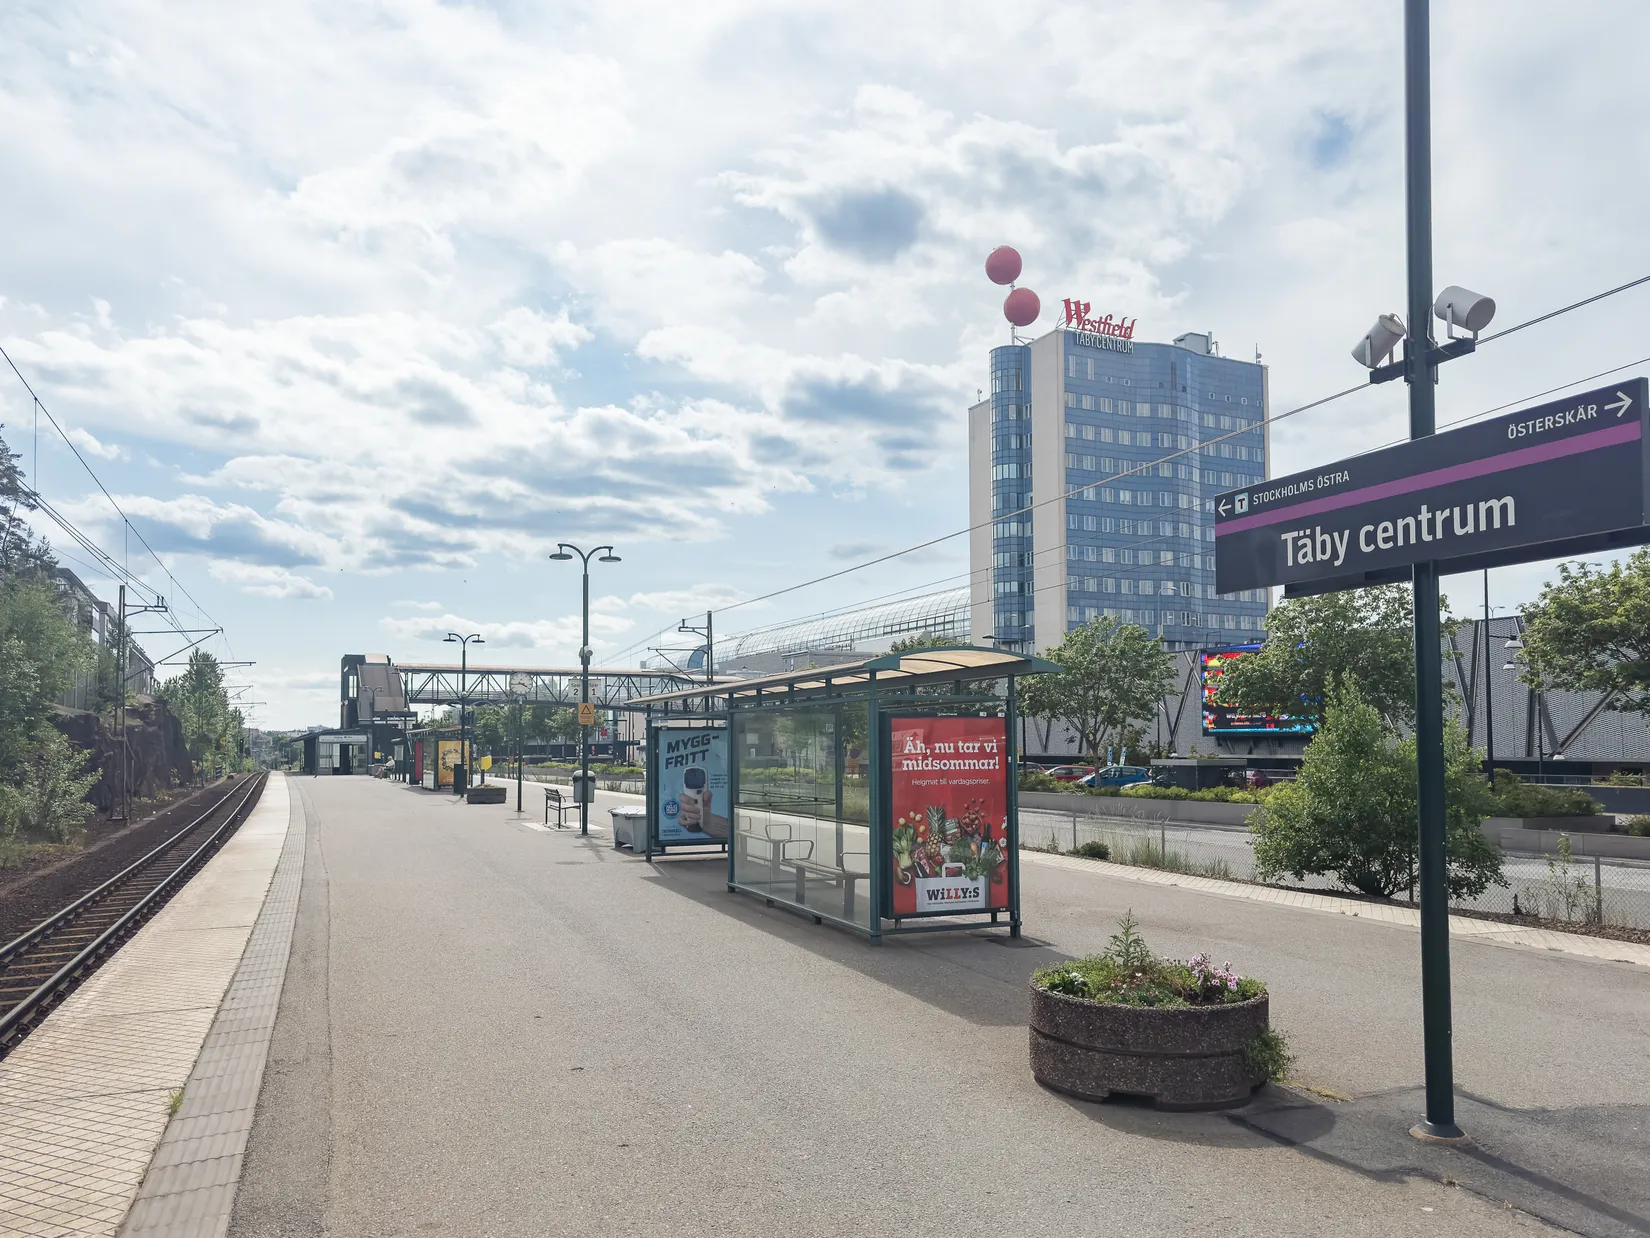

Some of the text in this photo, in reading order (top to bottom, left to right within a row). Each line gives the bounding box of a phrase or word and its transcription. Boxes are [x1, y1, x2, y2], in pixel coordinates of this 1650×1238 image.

[1064, 298, 1137, 340] Westfield
[1096, 335, 1134, 354] CENTRUM
[1507, 404, 1598, 440] ÖSTERSKÄR
[1252, 479, 1314, 505] STOCKHOLMS
[1316, 470, 1350, 489] ÖSTRA
[1280, 495, 1516, 567] Täby centrum
[666, 733, 720, 754] MYGG-
[903, 736, 931, 756] Äh,
[934, 741, 955, 753] nu
[957, 740, 981, 753] tar
[983, 738, 998, 753] vi
[664, 749, 709, 770] FRITT
[902, 756, 1000, 771] midsommar!
[939, 777, 947, 785] till
